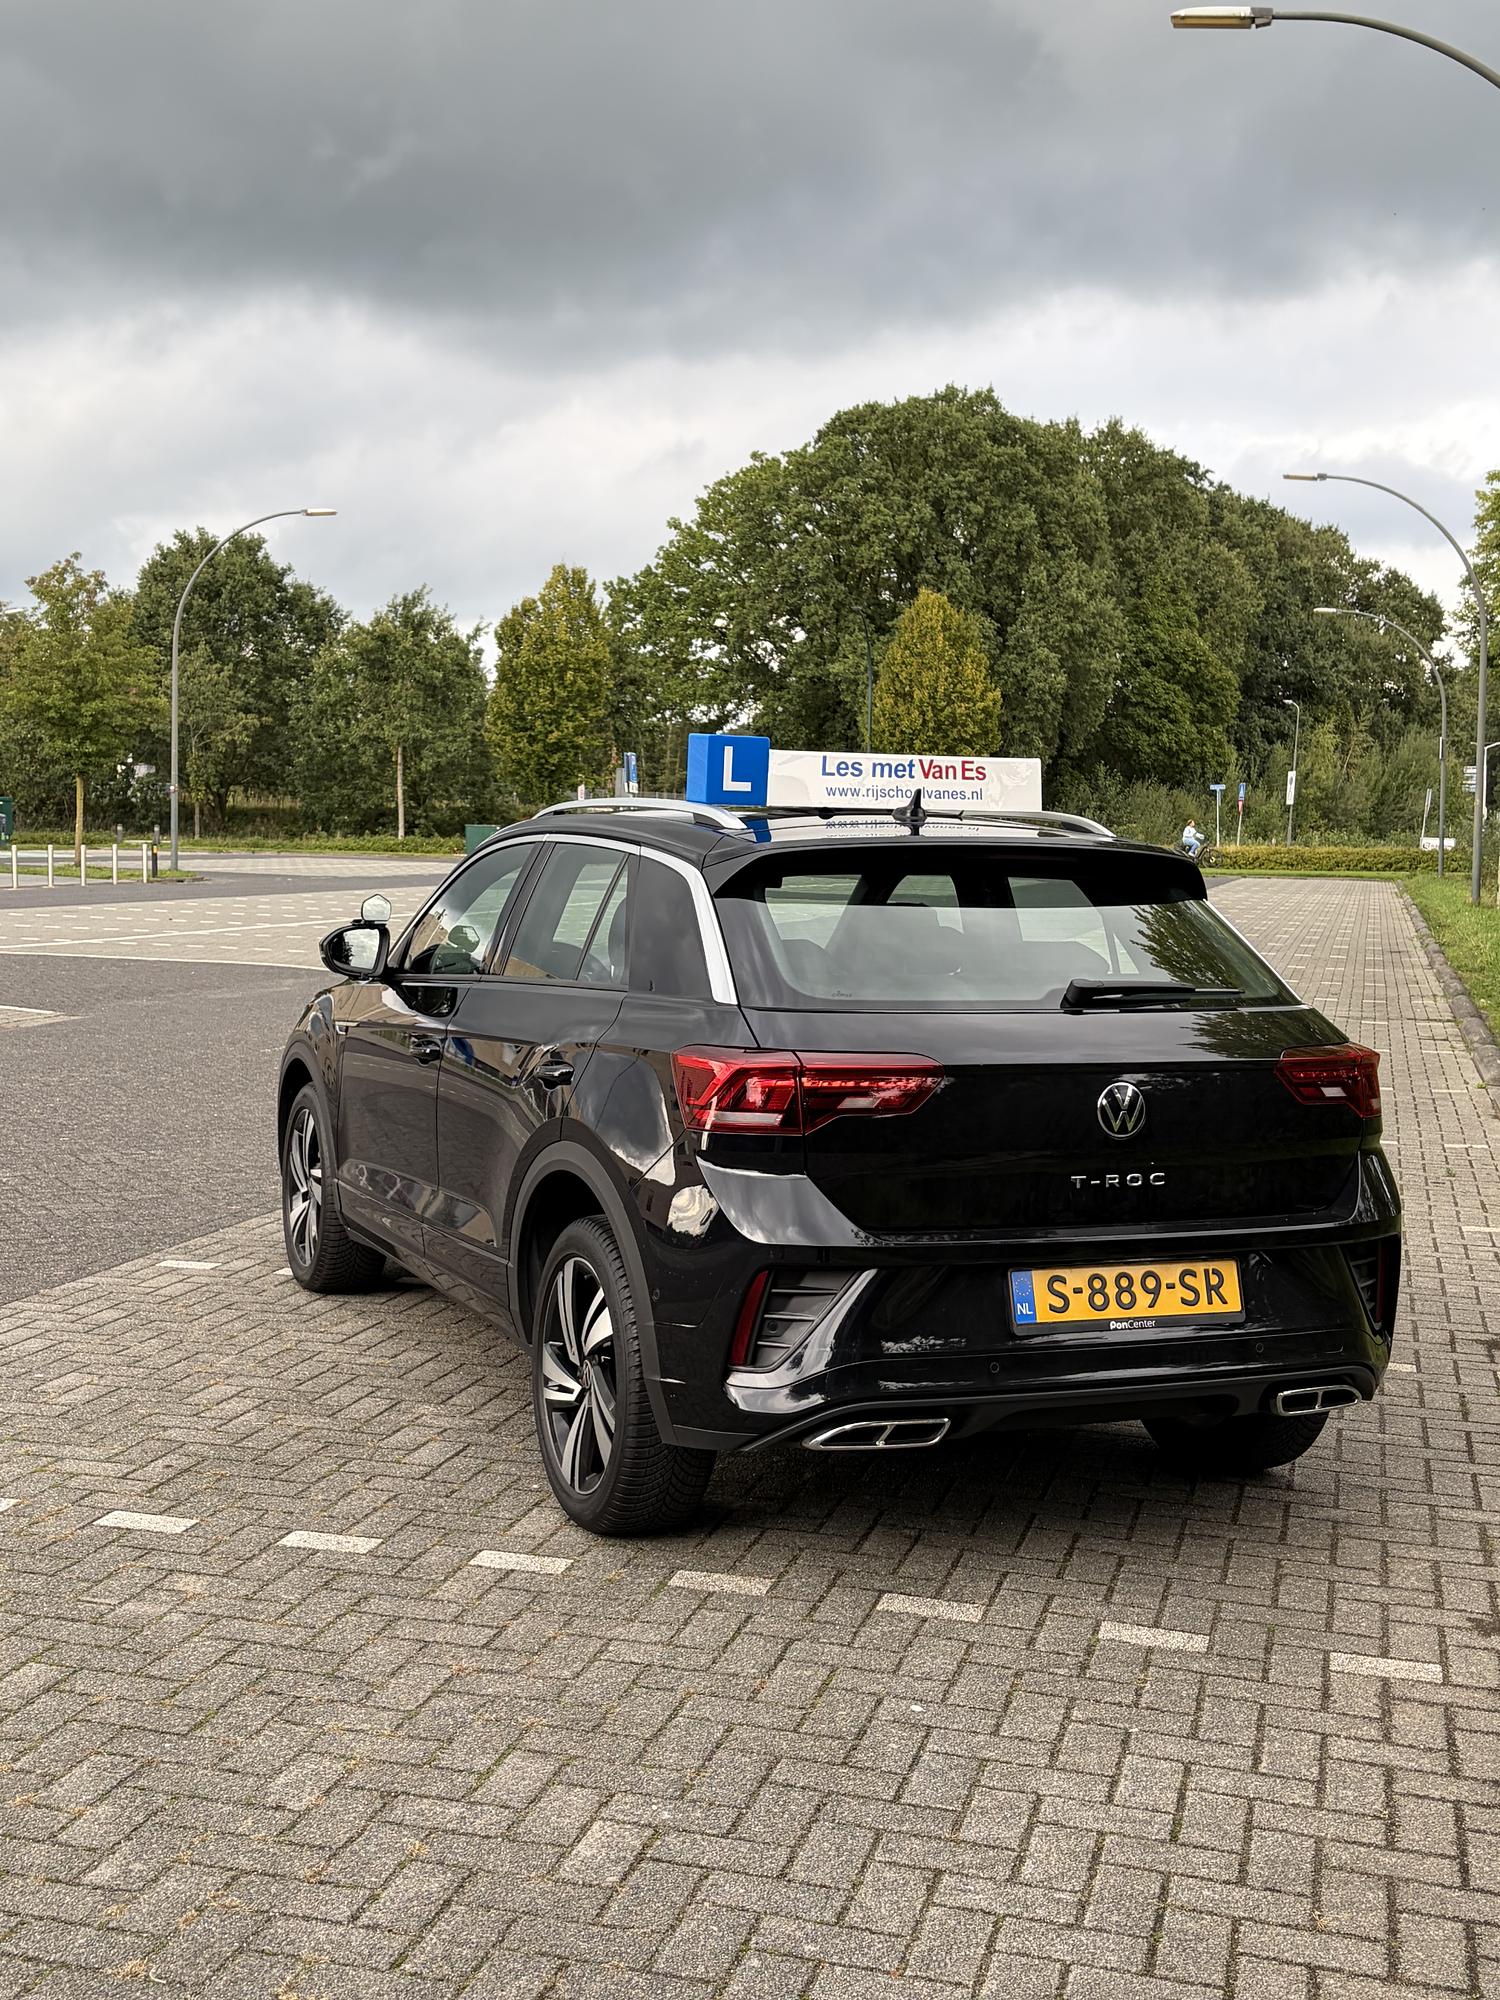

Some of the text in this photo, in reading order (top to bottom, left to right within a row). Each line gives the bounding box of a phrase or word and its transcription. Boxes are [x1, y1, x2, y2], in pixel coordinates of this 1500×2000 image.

[722, 745, 752, 791] L
[821, 755, 863, 777] Les
[871, 758, 915, 779] met
[825, 784, 983, 801] www.rijscholvanes.nl
[1070, 1172, 1166, 1189] T-ROC
[1046, 1267, 1229, 1314] S-889-SR
[1016, 1303, 1034, 1316] NL
[1109, 1319, 1156, 1330] PonCenter
